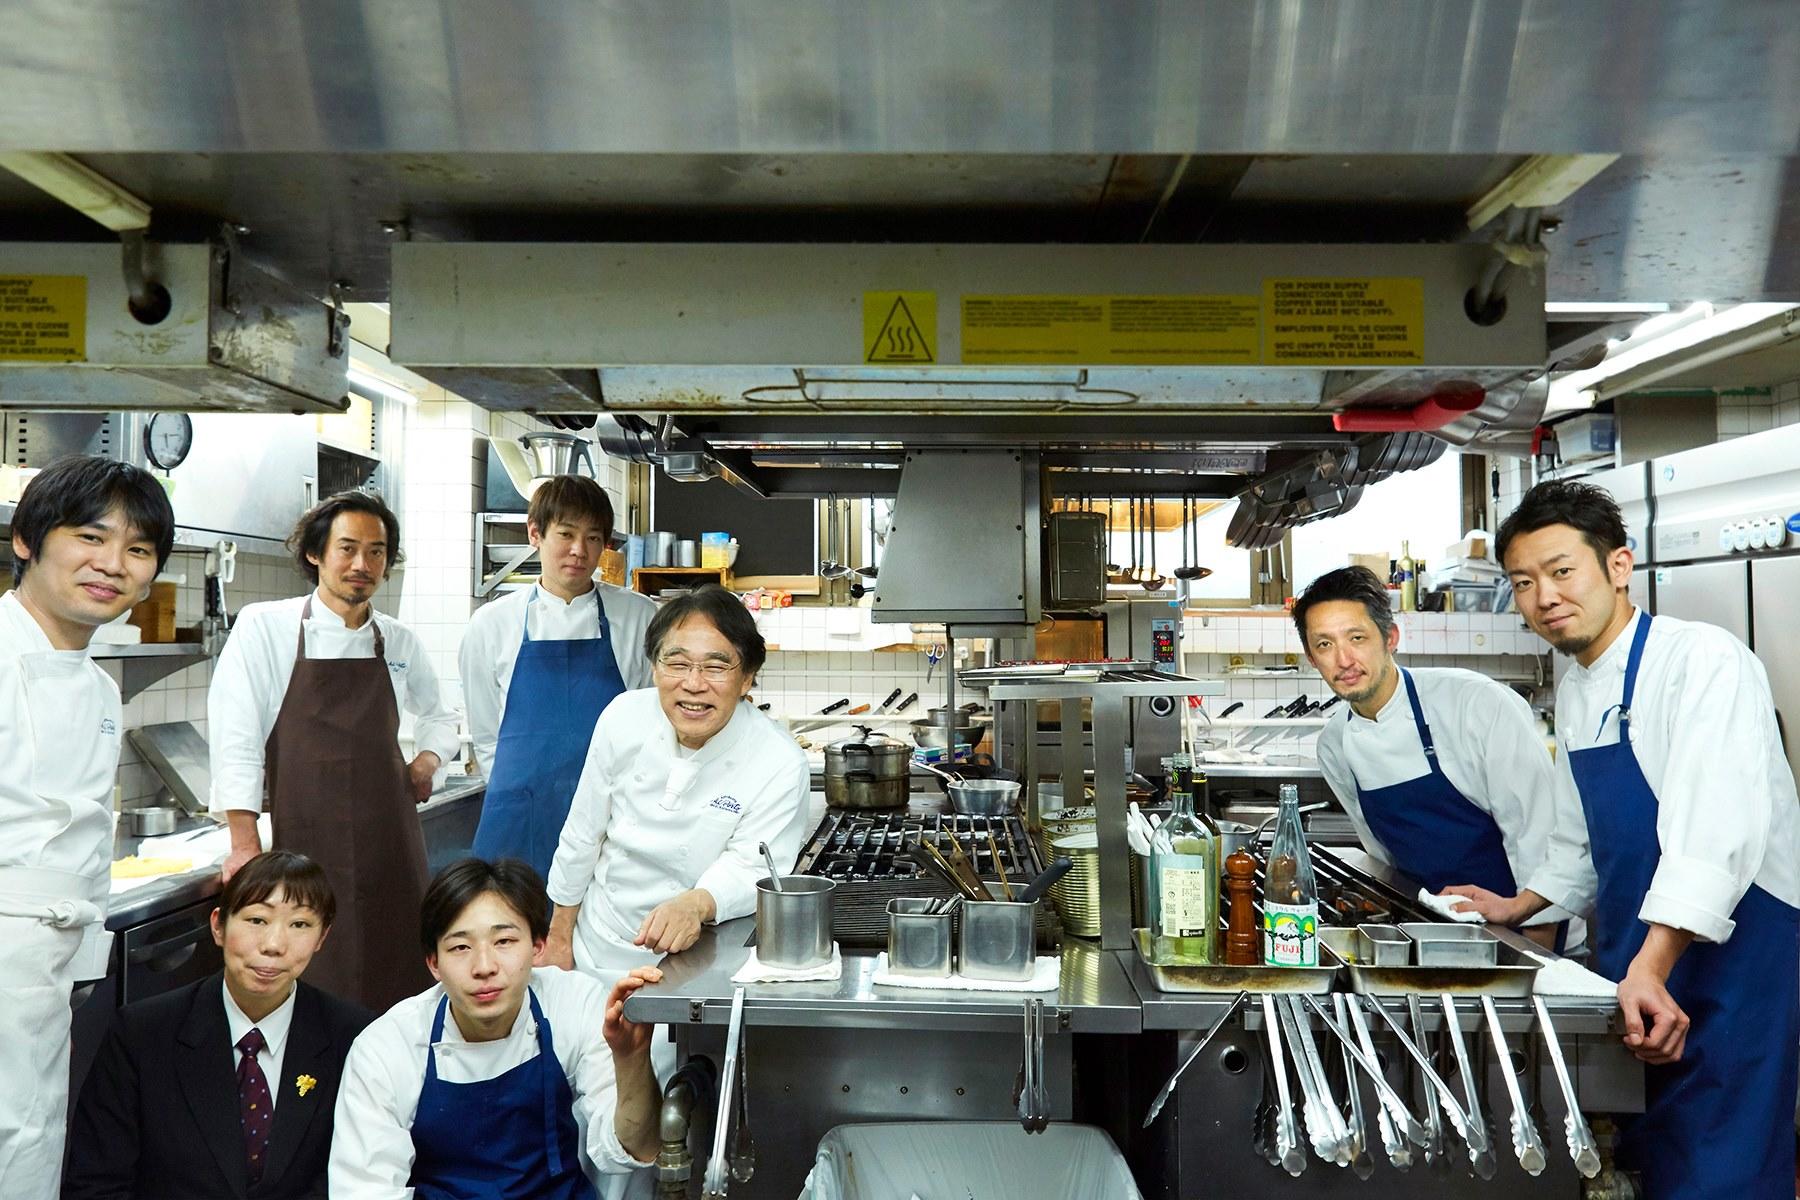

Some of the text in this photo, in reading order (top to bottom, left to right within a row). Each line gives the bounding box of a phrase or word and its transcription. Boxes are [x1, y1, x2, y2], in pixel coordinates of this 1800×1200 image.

[1274, 282, 1369, 290] FOR POWER SUPPLY
[1274, 290, 1365, 299] CONNECTIONS USE
[1274, 299, 1385, 307] COPPER WIRE SUITABLE
[1274, 308, 1294, 316] FOR
[1296, 308, 1308, 316] AT
[1310, 308, 1338, 316] LEAST
[1275, 325, 1324, 333] EMPLOYER
[1358, 325, 1371, 333] DE
[1373, 325, 1407, 333] CUIVRE
[1333, 334, 1360, 342] POUR
[1362, 334, 1375, 342] AU
[1328, 342, 1354, 351] POUR
[1357, 342, 1375, 351] LES
[1275, 351, 1335, 359] CONNEXIONS
[1275, 943, 1300, 954] FUJI
